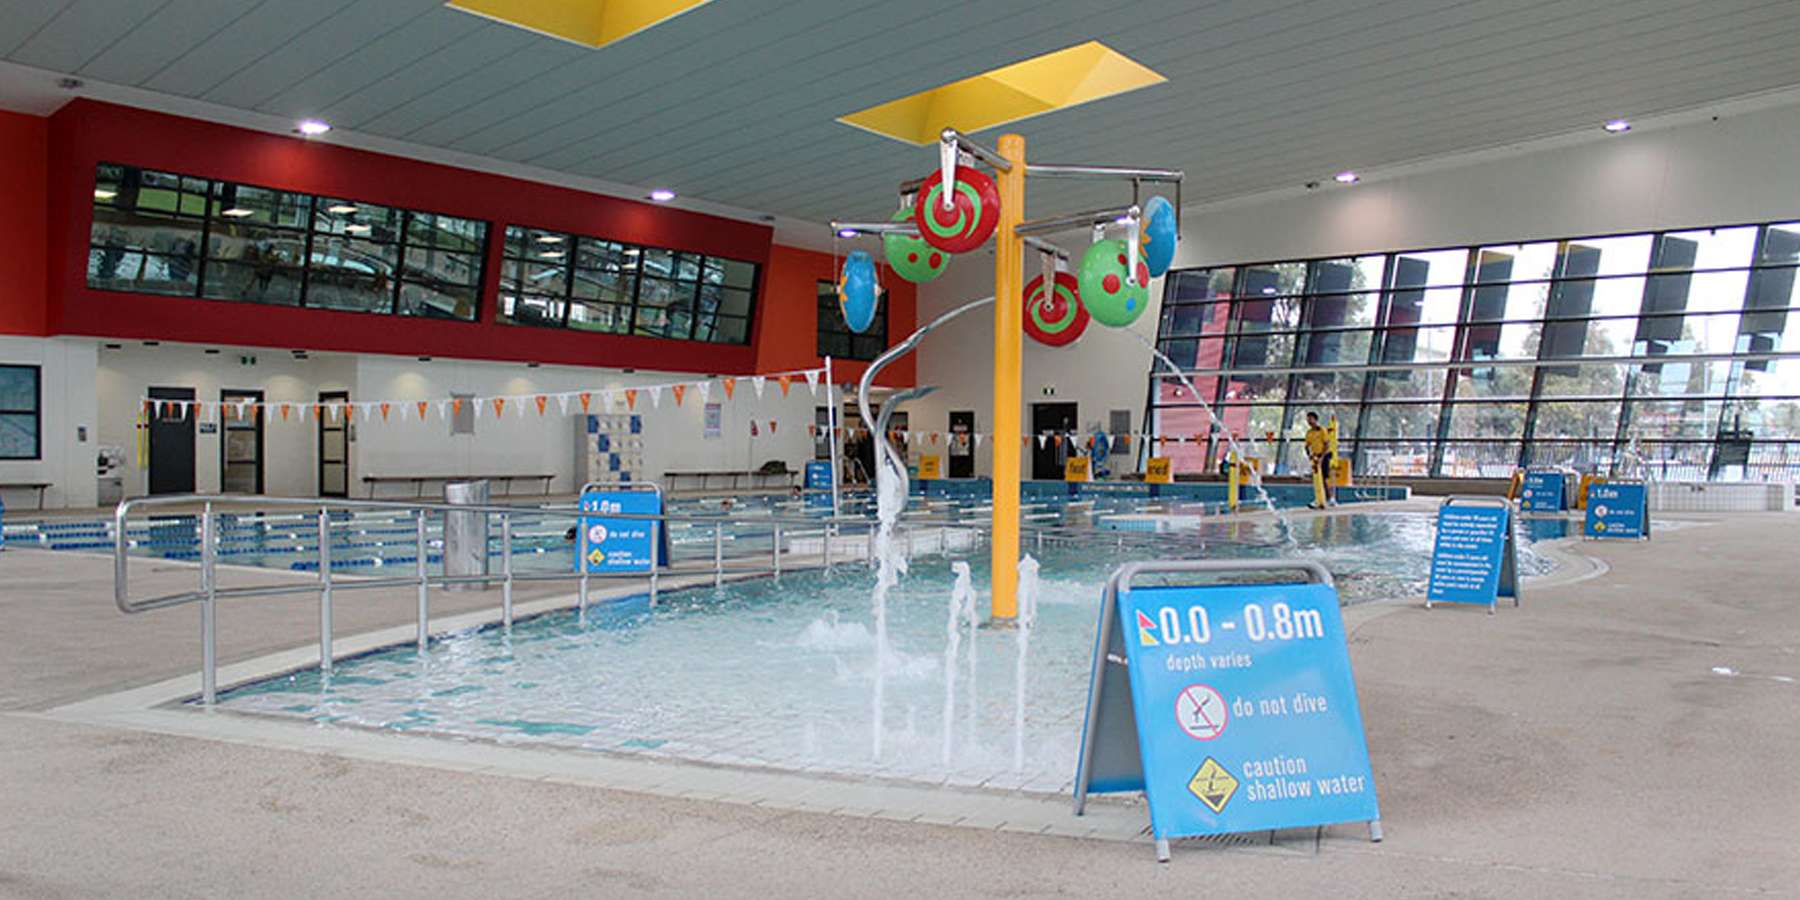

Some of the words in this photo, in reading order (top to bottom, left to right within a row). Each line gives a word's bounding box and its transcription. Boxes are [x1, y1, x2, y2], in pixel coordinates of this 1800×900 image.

[1159, 605, 1210, 645] 0.0
[1244, 603, 1324, 642] 0.8m
[1166, 654, 1206, 674] depth
[1210, 652, 1252, 668] varies
[1232, 696, 1254, 718] do
[1260, 695, 1287, 717] not
[1292, 691, 1327, 714] dive
[1243, 756, 1308, 778] caution
[1246, 777, 1312, 802] shallow
[1317, 774, 1365, 795] water
